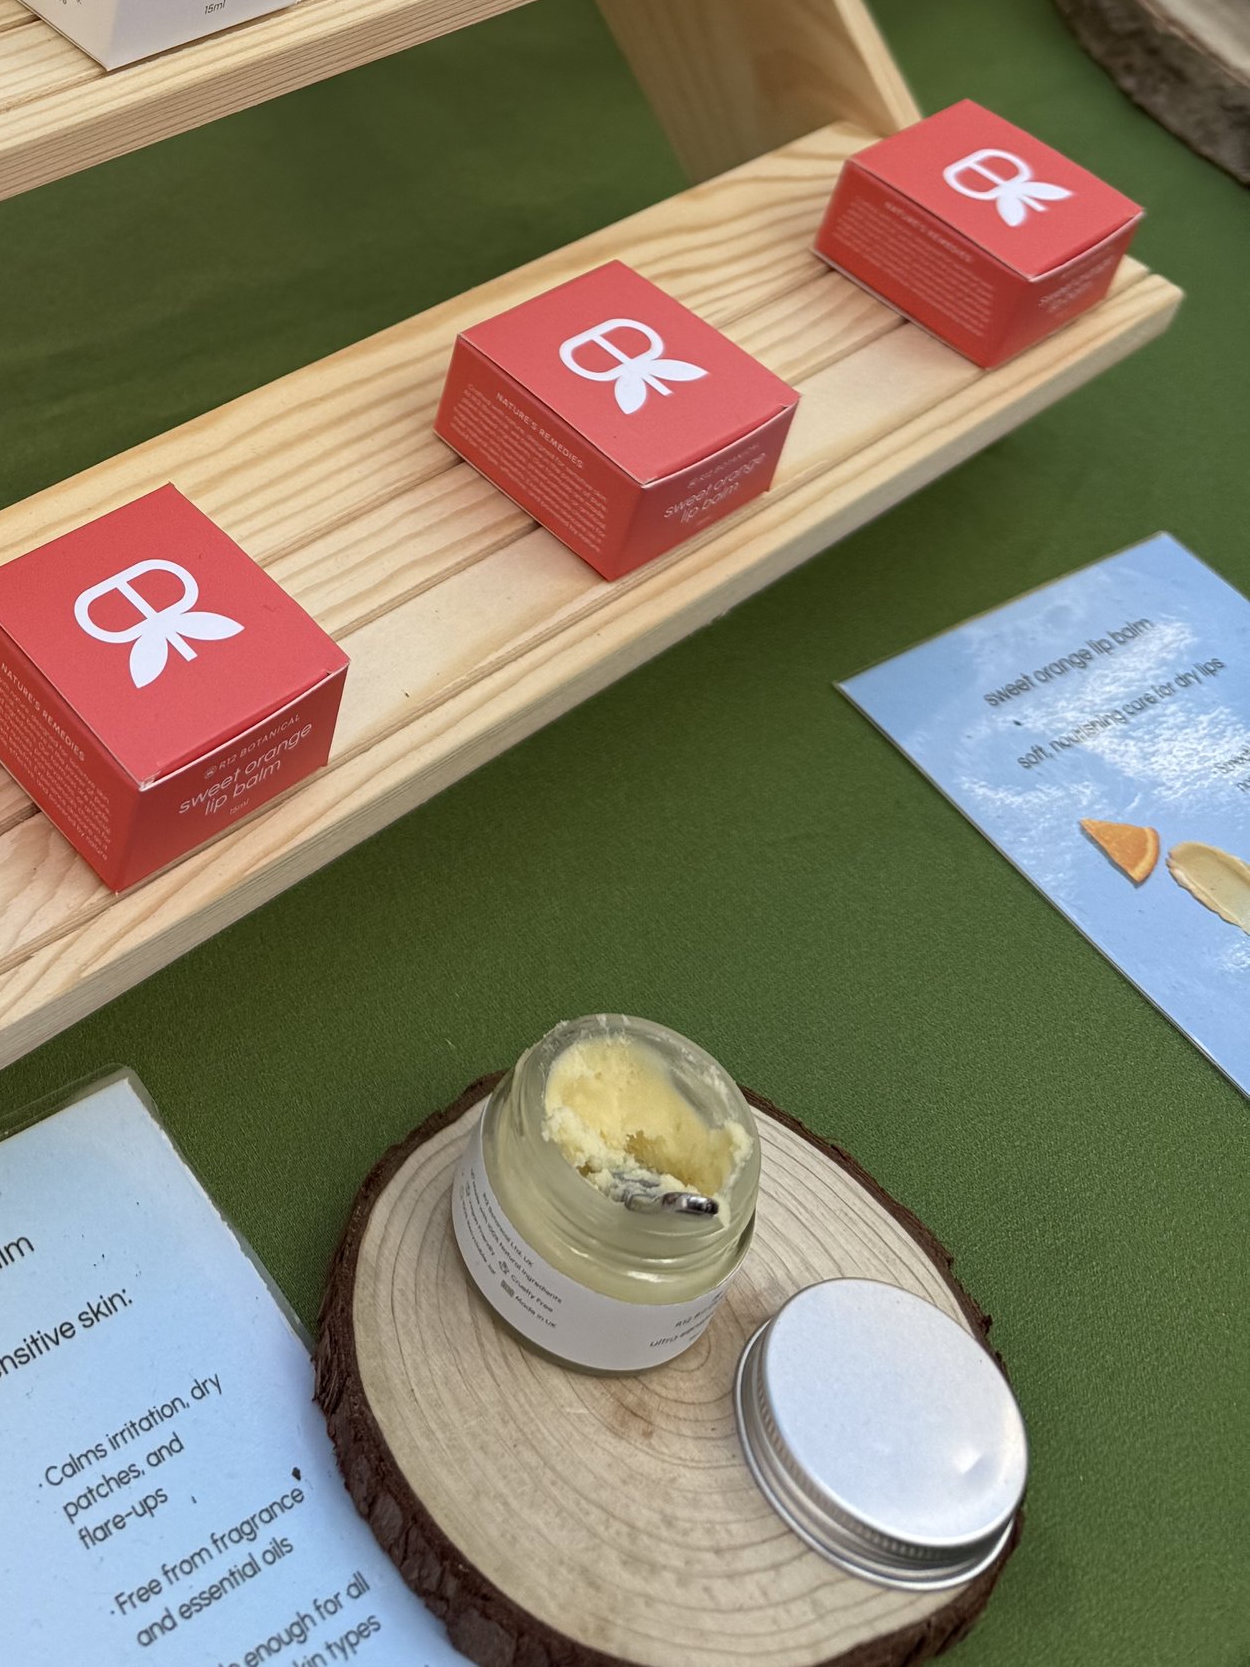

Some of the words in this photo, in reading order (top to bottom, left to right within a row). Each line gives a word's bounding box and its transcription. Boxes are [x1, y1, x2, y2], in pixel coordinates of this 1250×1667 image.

[204, 0, 226, 14] 15ml
[496, 392, 537, 430] NATURE'S
[539, 428, 582, 468] REMEDIES
[984, 673, 1035, 707] sweet
[1033, 648, 1093, 683] orange
[1085, 639, 1113, 655] lip
[1106, 618, 1155, 644] balm
[1, 662, 40, 711] NATURE'S
[42, 709, 84, 761] REMEDIES
[219, 754, 238, 772] R12
[240, 713, 301, 757] BOTANICAL
[178, 765, 241, 814] sweet
[244, 722, 313, 775] orange
[204, 792, 228, 817] lip
[233, 759, 282, 798] balm
[77, 1287, 133, 1329] skin:
[104, 1396, 191, 1451] irritation,
[189, 1372, 222, 1401] dry
[61, 1462, 146, 1525] patches,
[145, 1432, 185, 1468] and
[77, 1487, 169, 1550] flare-ups
[160, 1546, 214, 1586] from
[209, 1487, 305, 1555] fragrance
[135, 1607, 178, 1648] and
[177, 1555, 262, 1621] essential
[261, 1536, 294, 1566] oils
[243, 1612, 318, 1667] enough
[311, 1590, 344, 1621] for
[345, 1571, 371, 1600] all
[324, 1615, 382, 1661] types
